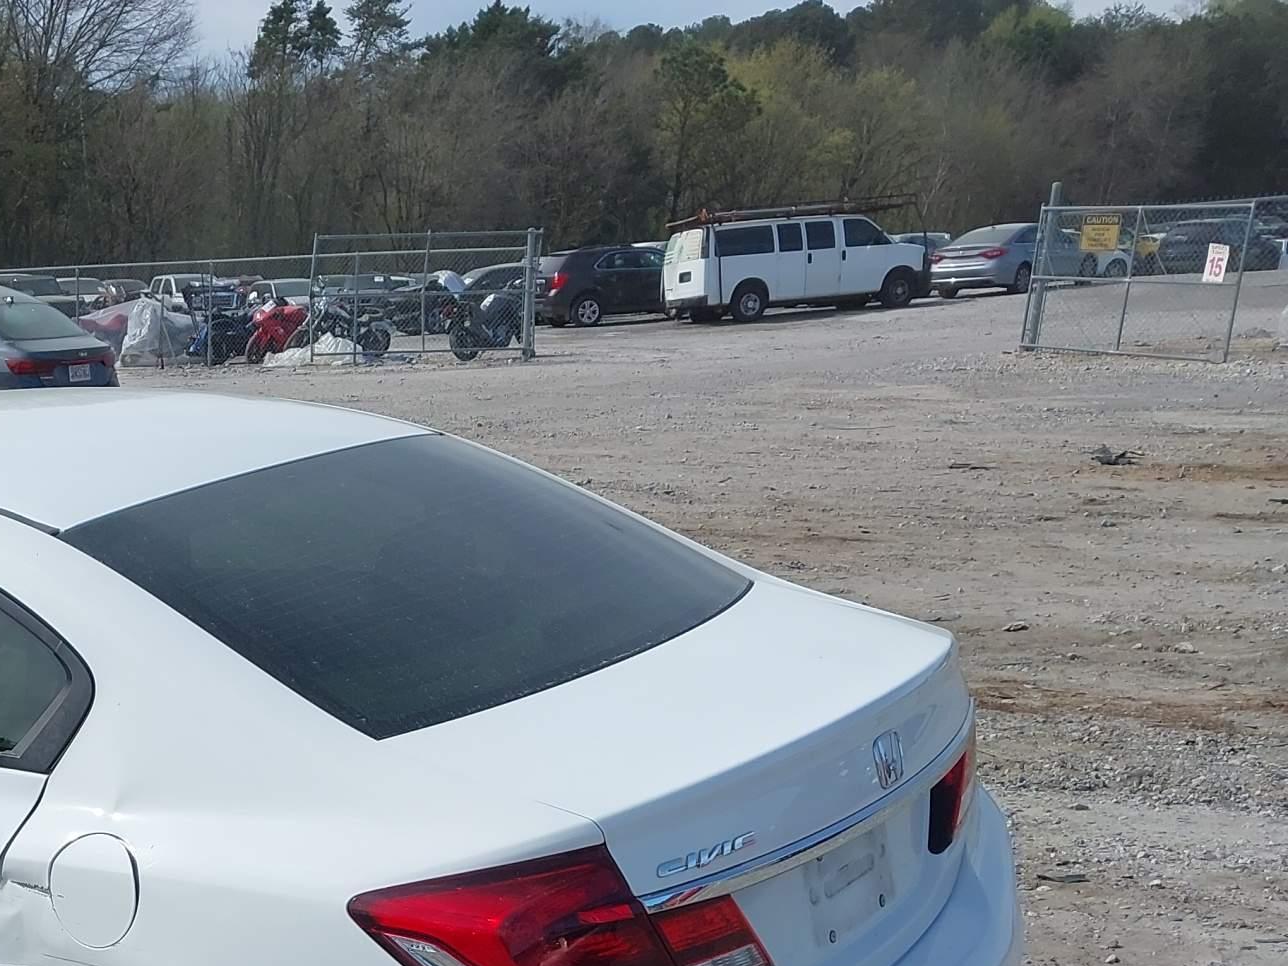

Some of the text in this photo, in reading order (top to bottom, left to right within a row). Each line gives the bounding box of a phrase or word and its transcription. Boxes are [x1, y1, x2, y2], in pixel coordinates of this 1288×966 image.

[1086, 215, 1119, 224] CAUTION
[1208, 256, 1224, 277] 15
[656, 831, 756, 878] CIVIC
